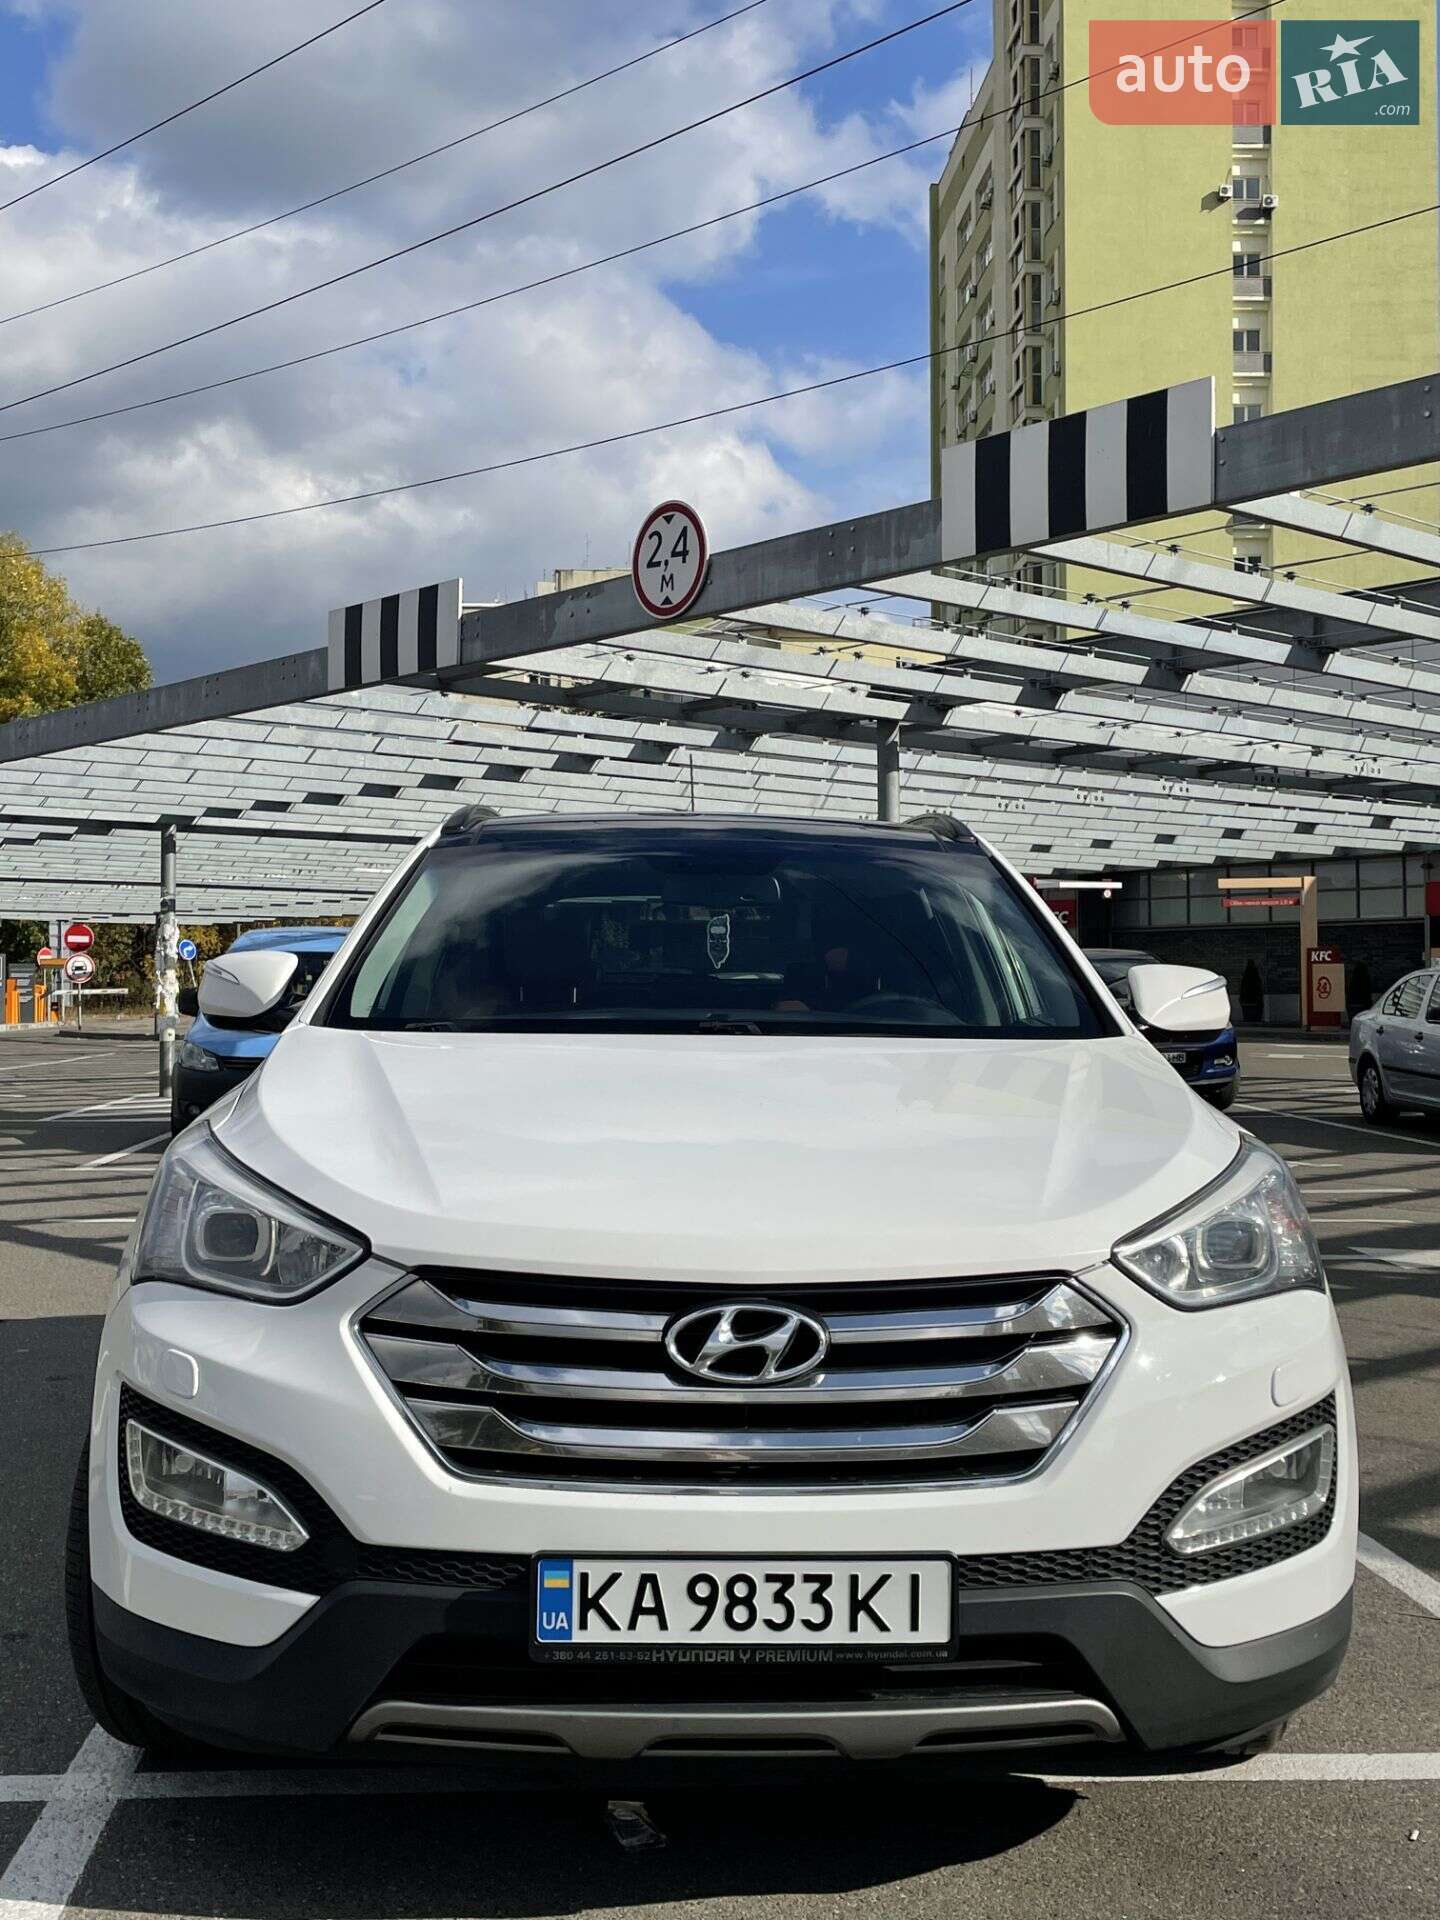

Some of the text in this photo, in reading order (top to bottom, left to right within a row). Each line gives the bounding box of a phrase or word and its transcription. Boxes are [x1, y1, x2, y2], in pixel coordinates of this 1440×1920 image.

[646, 525, 690, 572] 2,4
[1311, 950, 1332, 962] KFC
[578, 1572, 921, 1633] KA 9833 KI
[542, 1612, 569, 1631] UA
[652, 1649, 735, 1662] HYUNDAI
[756, 1649, 833, 1663] PREMIUM
